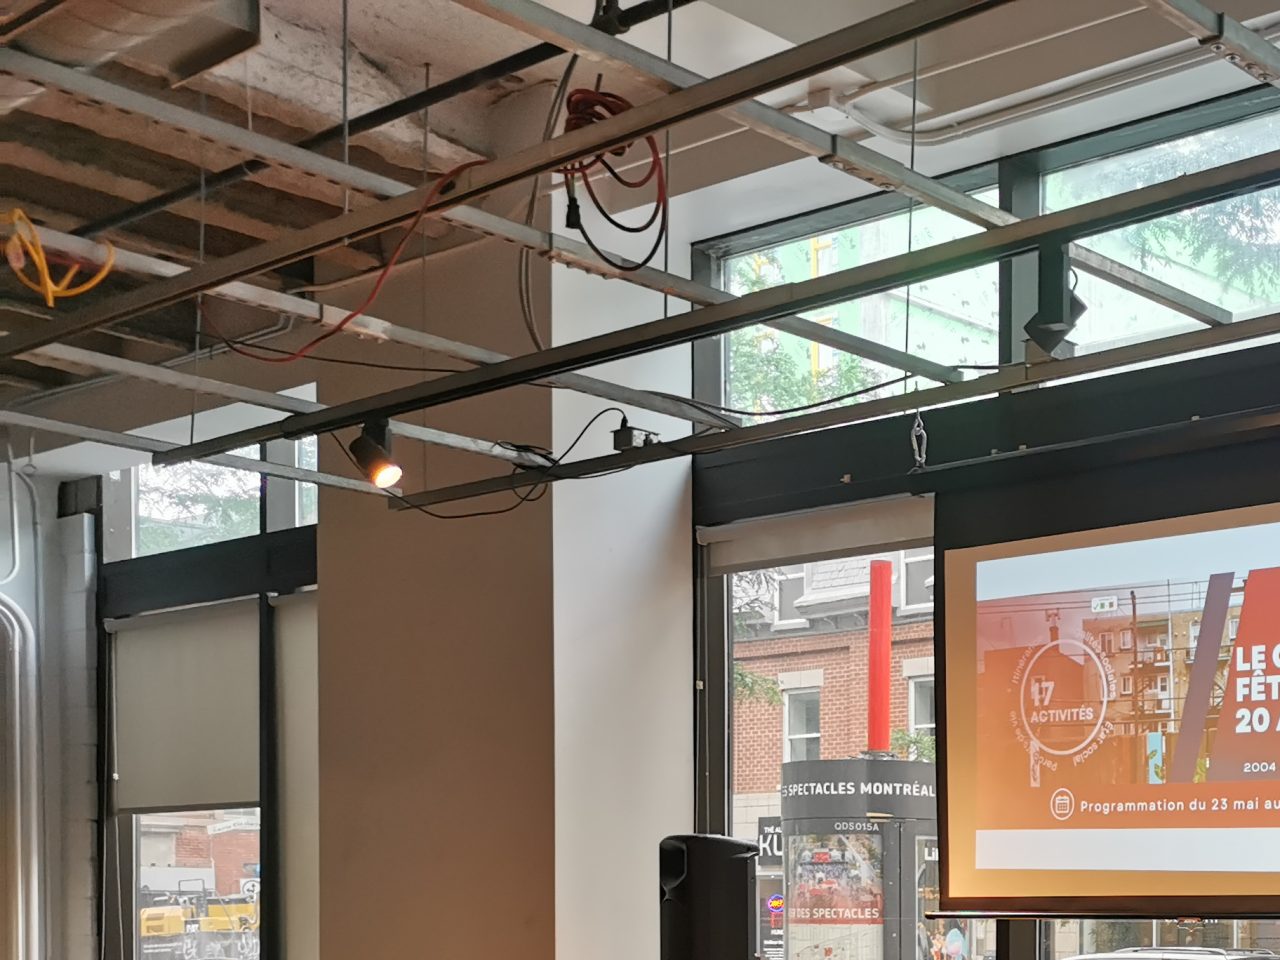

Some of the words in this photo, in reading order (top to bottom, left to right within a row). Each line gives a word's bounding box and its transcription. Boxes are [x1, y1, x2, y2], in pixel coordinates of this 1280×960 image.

[1236, 645, 1267, 671] LE
[1031, 681, 1055, 706] 17
[1030, 704, 1094, 723] ACTIVITÉS
[1235, 707, 1270, 733] 20
[1072, 742, 1099, 768] social
[1243, 762, 1276, 773] 2004
[788, 782, 856, 797] SPECTACLES
[860, 780, 936, 798] MONTRÉAL
[1080, 800, 1184, 814] Programmation
[1189, 799, 1206, 811] du
[1211, 798, 1228, 810] 23
[1233, 797, 1259, 810] mai
[812, 907, 880, 919] SPECTACLES
